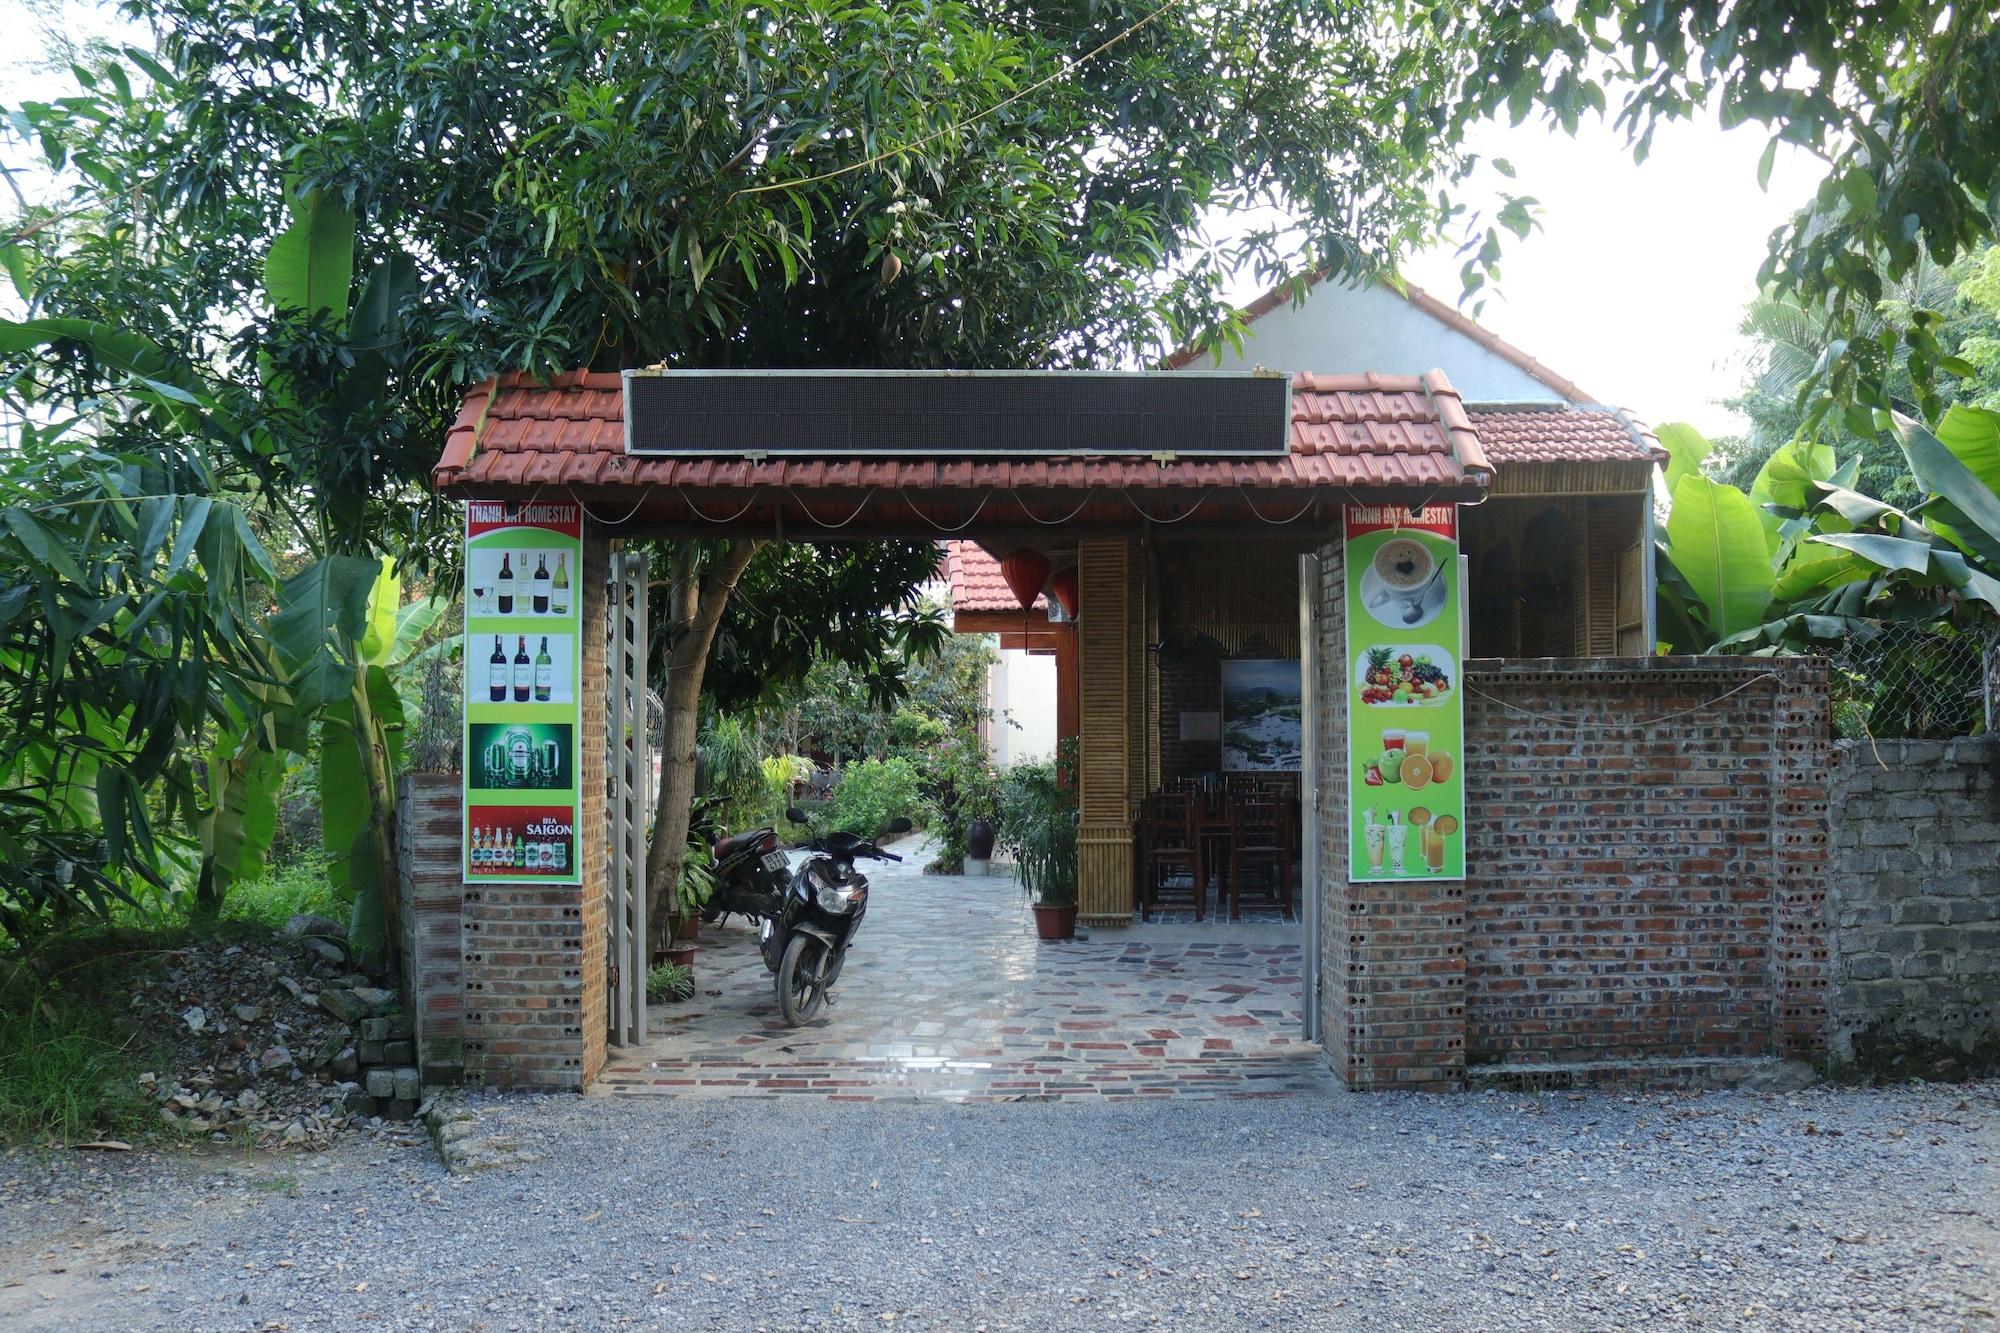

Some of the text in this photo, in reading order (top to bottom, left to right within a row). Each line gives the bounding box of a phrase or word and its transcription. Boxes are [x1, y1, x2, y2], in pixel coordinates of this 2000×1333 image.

[470, 505, 502, 523] THANH
[525, 505, 577, 523] HOMESTAY
[1349, 507, 1381, 525] THANH
[542, 817, 557, 825] BIA
[526, 824, 573, 836] SAIGON
